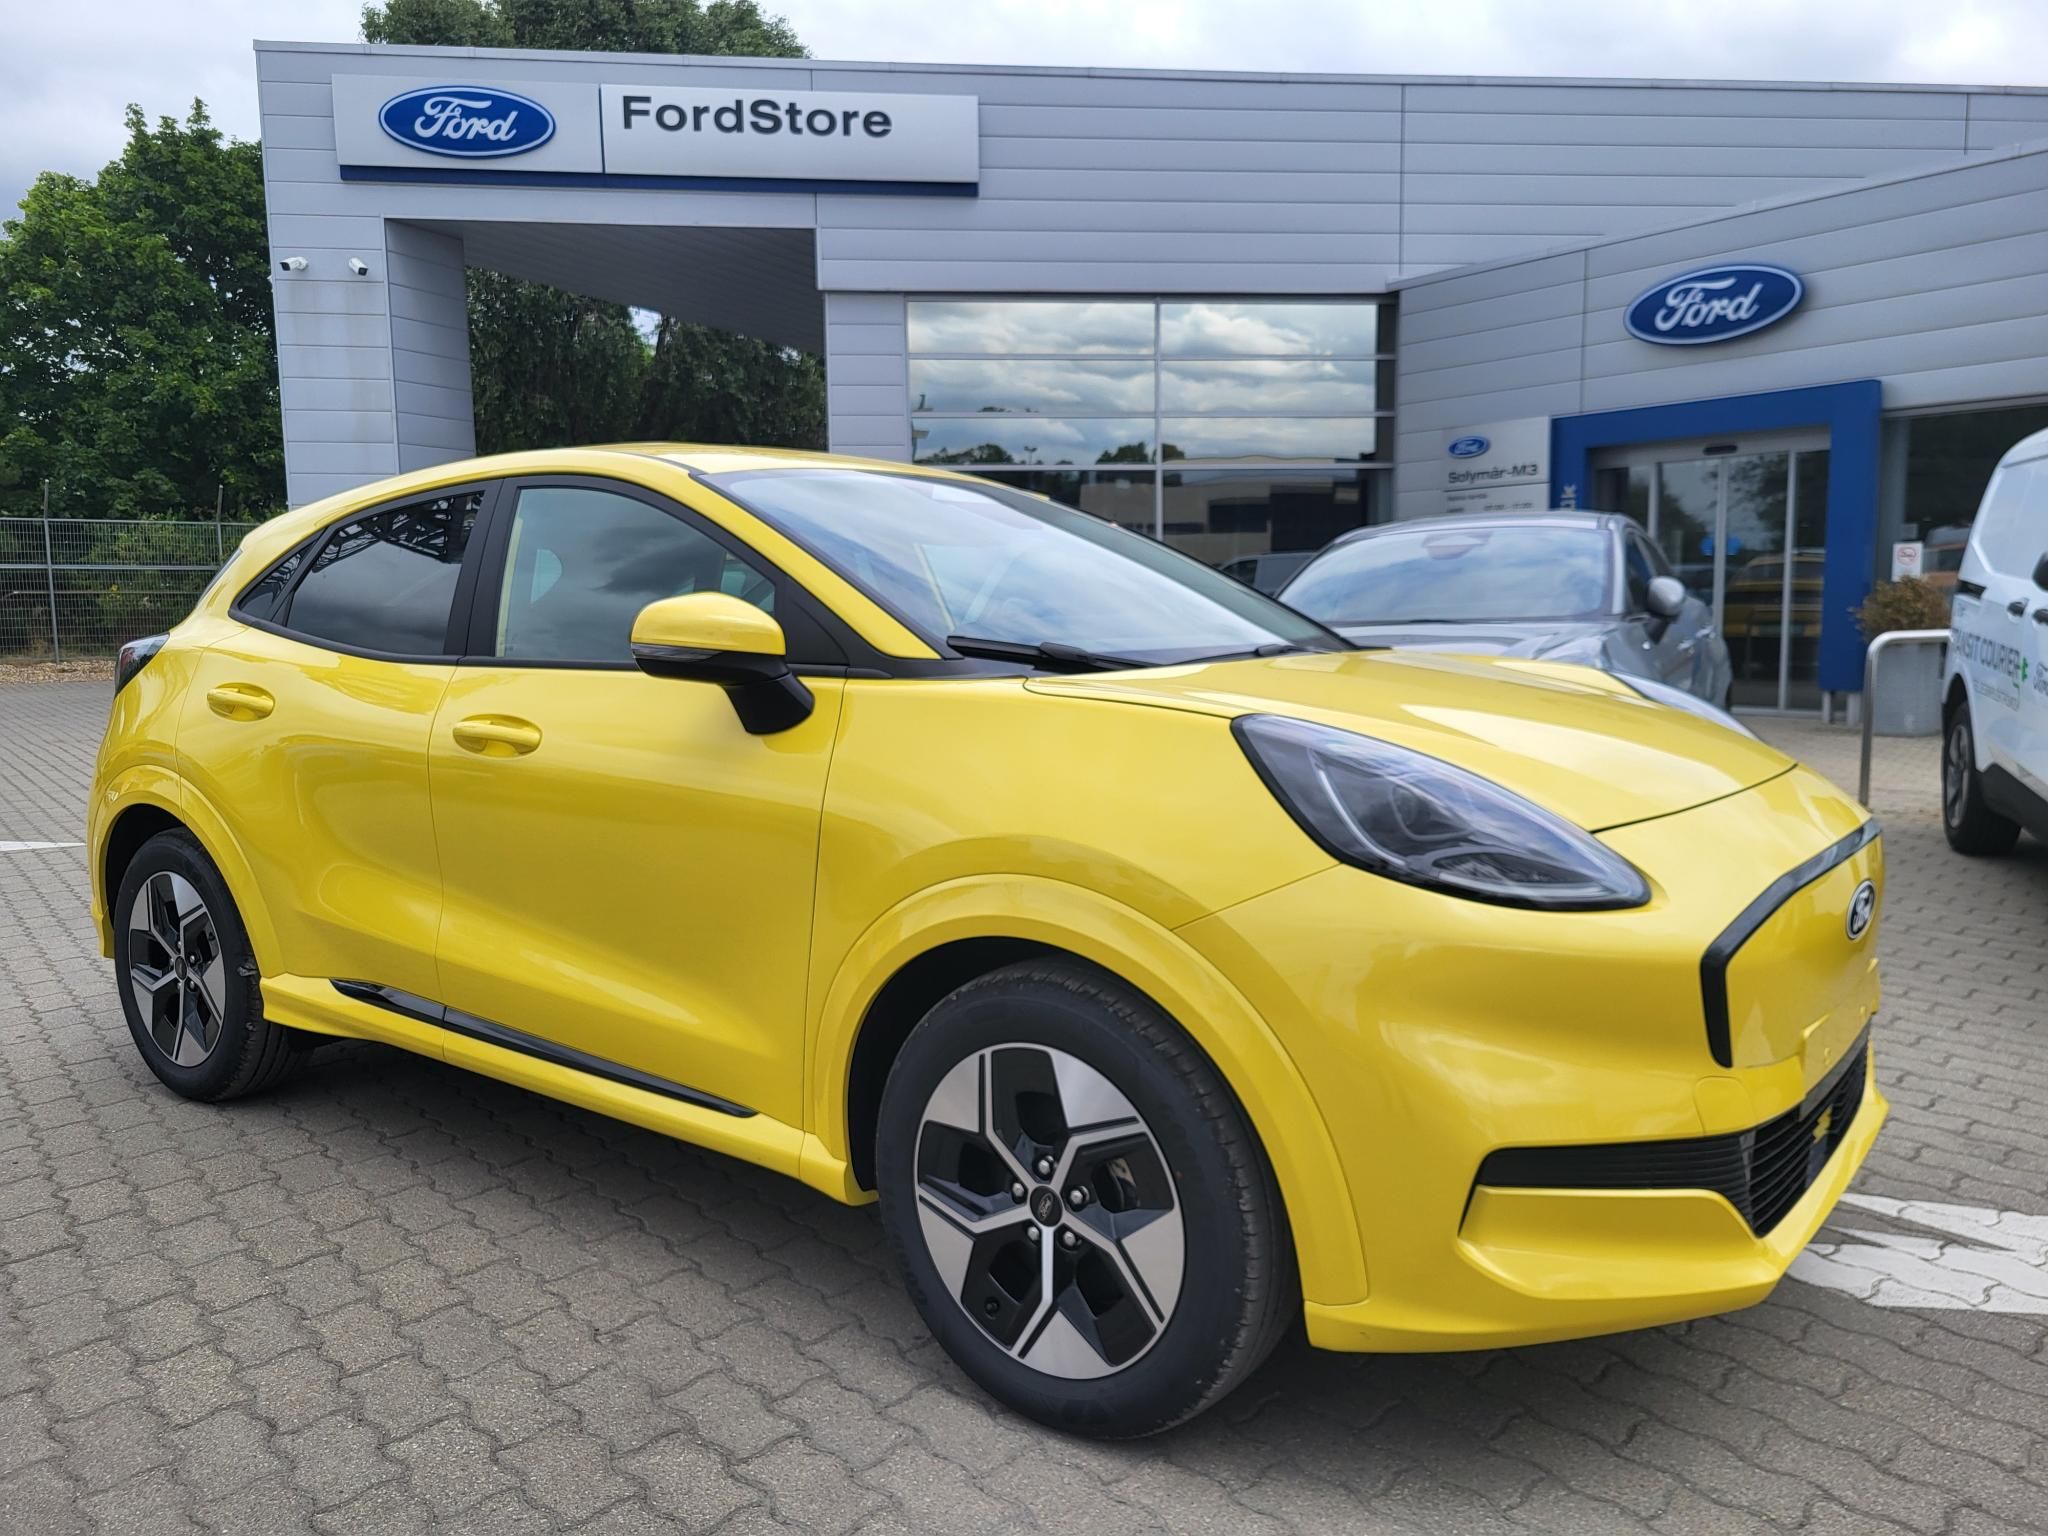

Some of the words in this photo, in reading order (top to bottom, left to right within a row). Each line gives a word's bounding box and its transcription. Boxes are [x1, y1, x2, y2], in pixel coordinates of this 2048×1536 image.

[414, 96, 518, 141] Ford
[623, 95, 892, 138] FordStore
[1654, 277, 1764, 331] Ford
